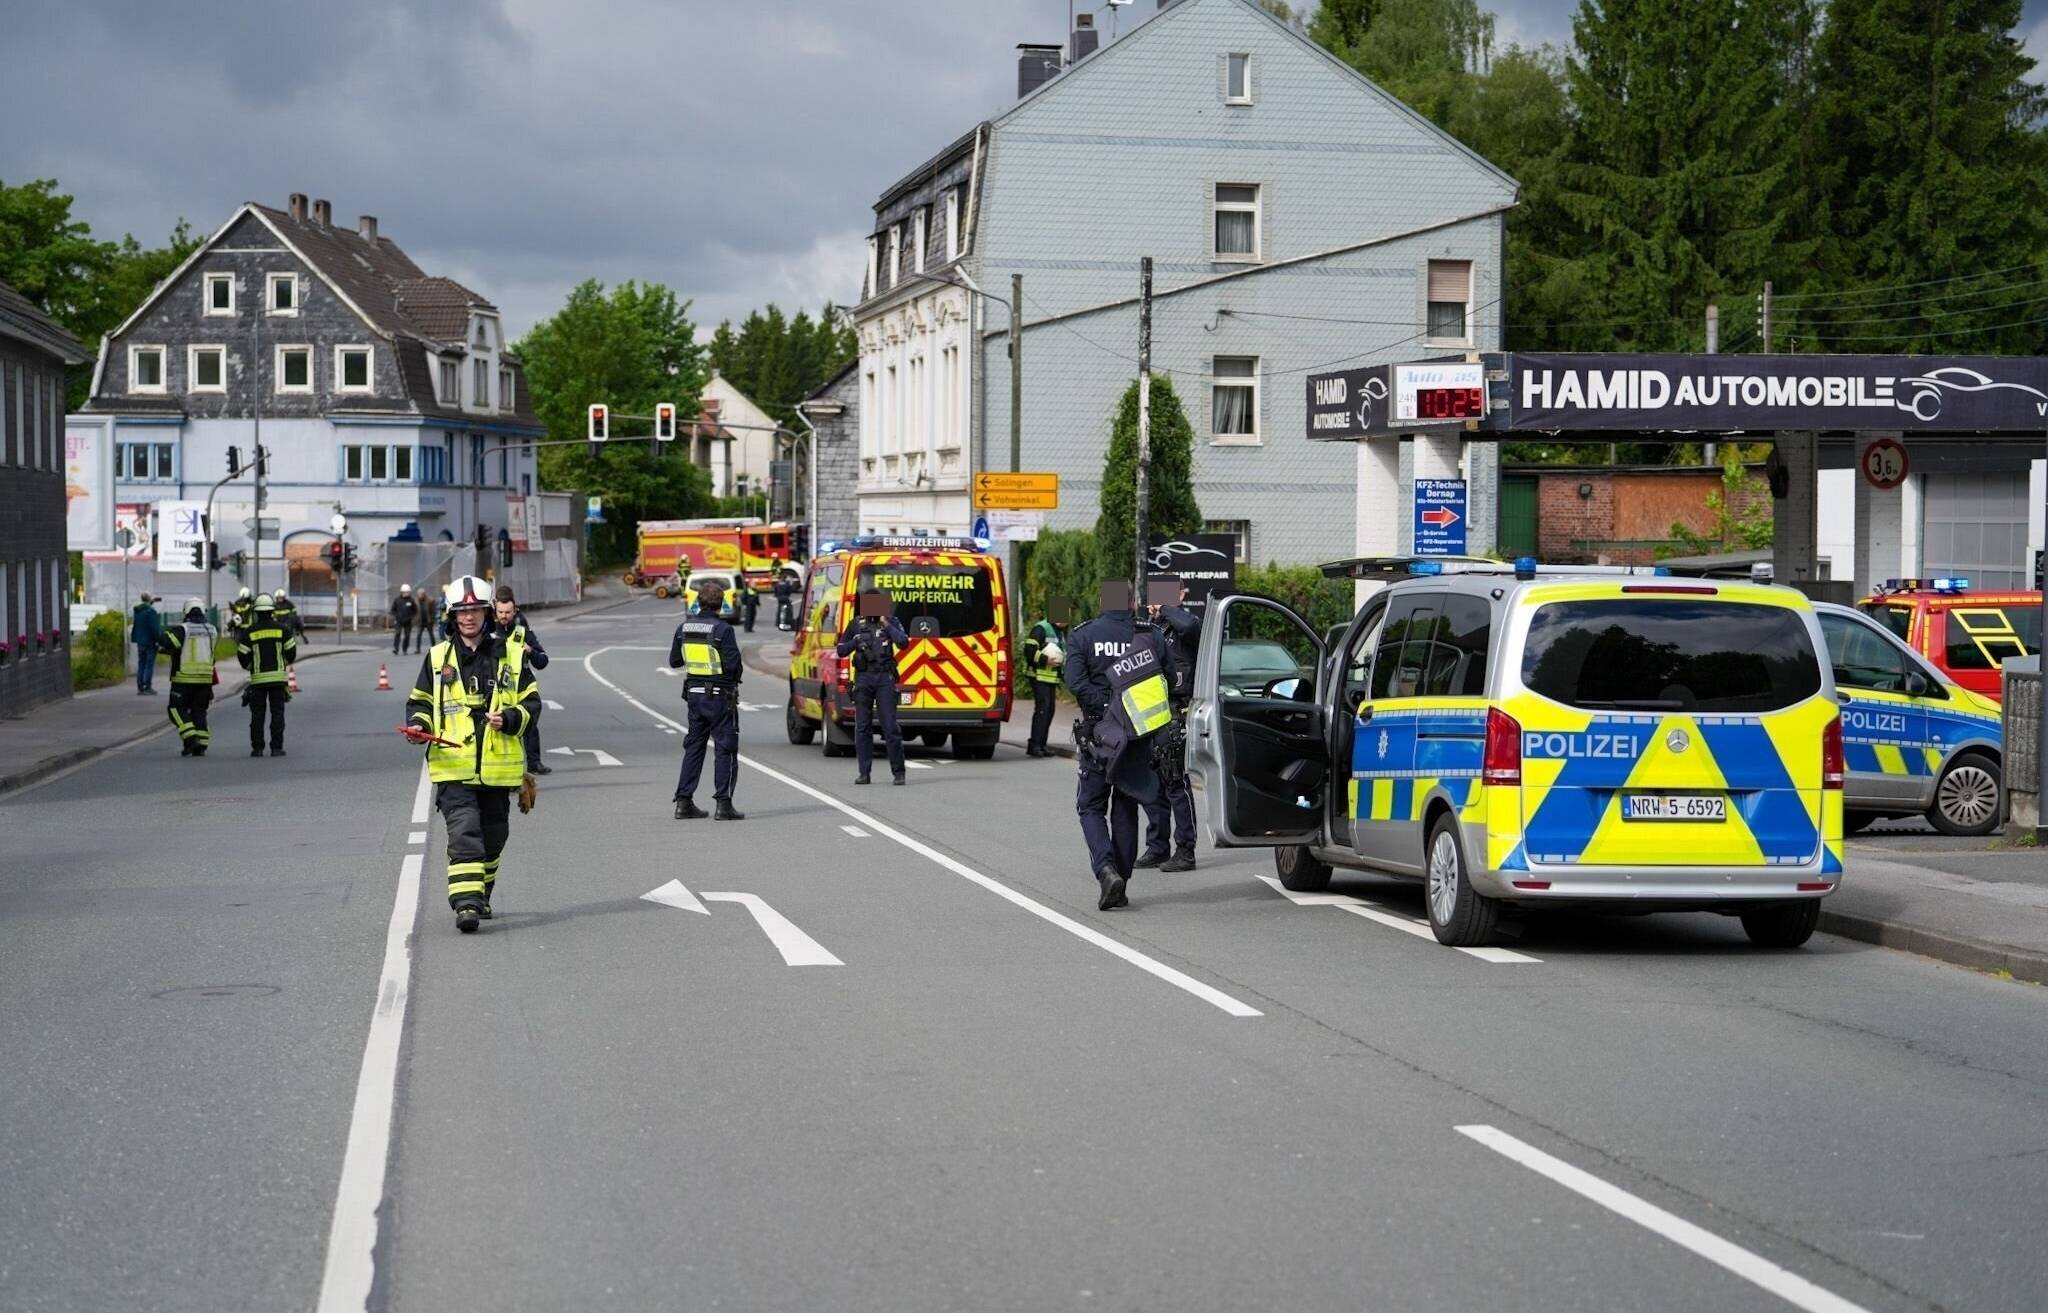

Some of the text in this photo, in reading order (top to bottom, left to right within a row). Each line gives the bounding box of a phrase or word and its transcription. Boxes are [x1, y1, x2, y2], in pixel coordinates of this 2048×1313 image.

[1316, 378, 1347, 405] HAMID
[1522, 370, 1897, 409] HAMID AUTOMOBILE
[1313, 411, 1350, 430] AUTOMOBILE
[994, 478, 1033, 488] Solingen
[1416, 481, 1465, 489] KFZ-Technik
[994, 495, 1040, 504] Vohwinkel
[1426, 489, 1455, 498] Dornap
[883, 537, 961, 547] EINSATZLEITUNG
[874, 574, 975, 589] FEUERWEHR
[891, 591, 962, 603] WUPPERTAL
[1113, 648, 1154, 676] POLIZEI
[1841, 711, 1906, 732] POLIZEI
[1525, 733, 1638, 758] POLIZEI
[1632, 799, 1724, 816] NRW 5-6592
